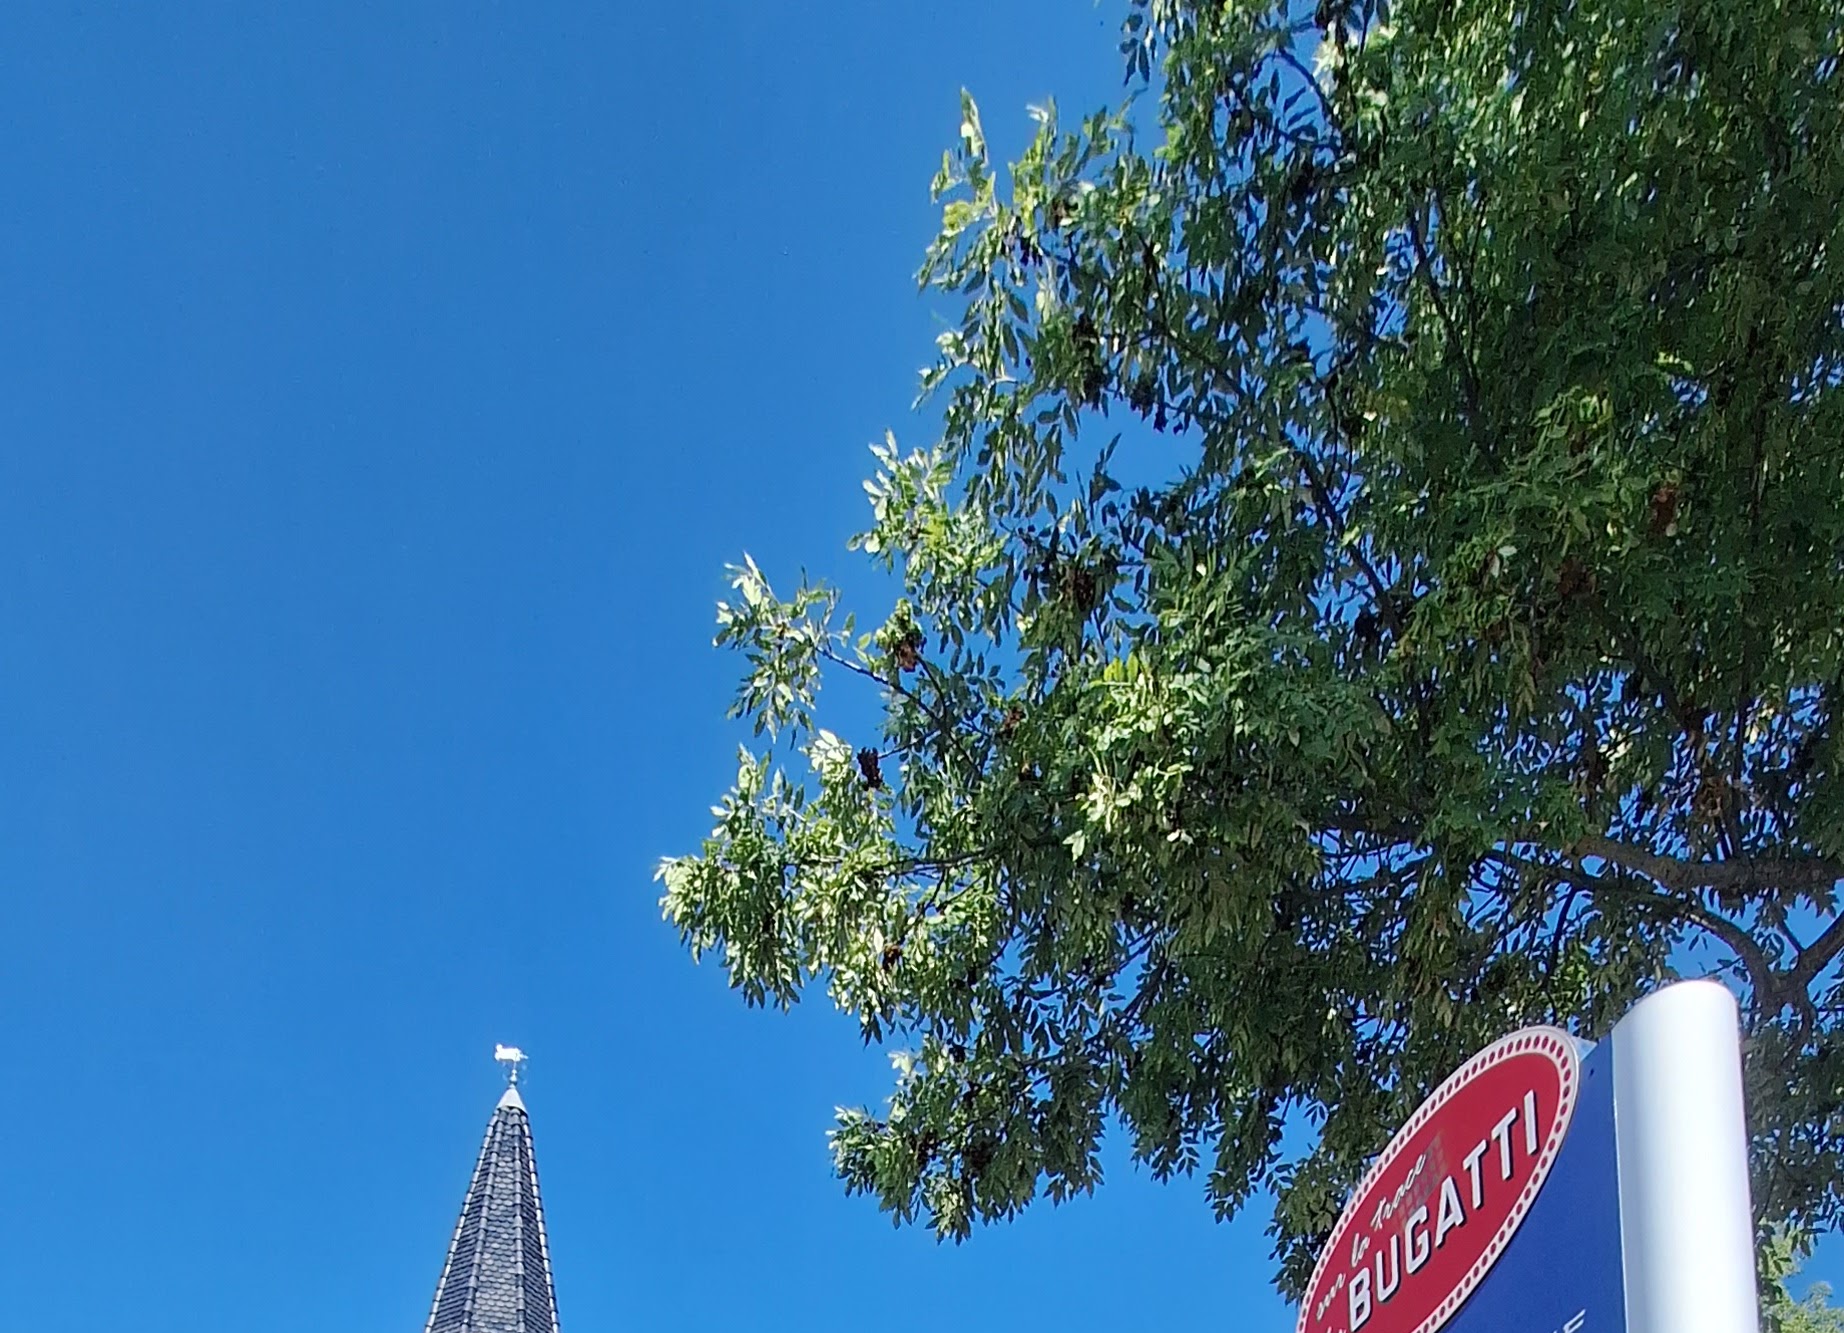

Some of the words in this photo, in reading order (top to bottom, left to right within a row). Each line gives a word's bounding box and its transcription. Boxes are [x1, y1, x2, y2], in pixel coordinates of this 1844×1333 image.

[1316, 1272, 1346, 1322] sur
[1351, 1232, 1370, 1268] la
[1371, 1153, 1426, 1231] trace
[1349, 1089, 1539, 1333] BUGATTI
